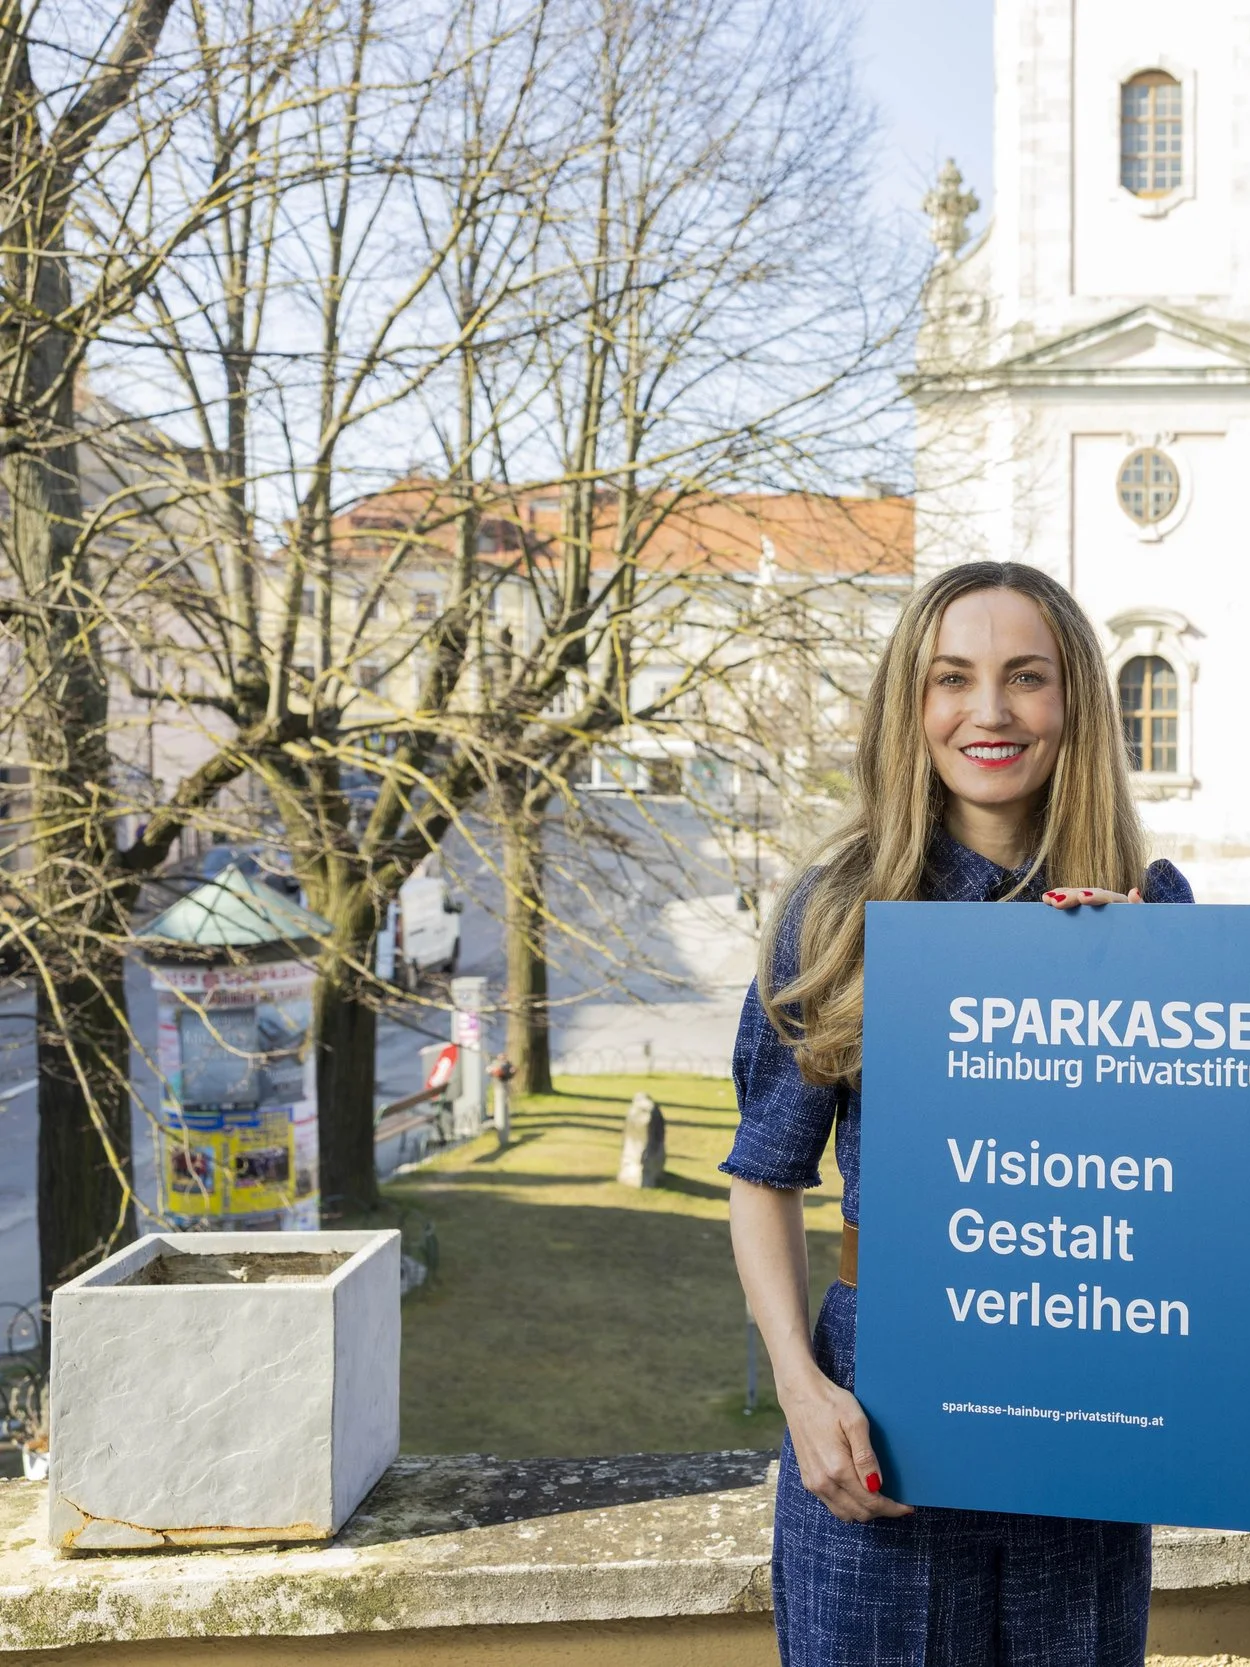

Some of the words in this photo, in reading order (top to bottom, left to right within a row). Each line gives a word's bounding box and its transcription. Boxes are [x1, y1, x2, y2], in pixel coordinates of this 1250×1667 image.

[947, 1050, 1083, 1089] Hainburg
[946, 1138, 1173, 1193] Visionen
[948, 1207, 1134, 1262] Gestalt
[945, 1282, 1189, 1336] verleihen
[941, 1401, 1164, 1428] sparkasse-hainburg-privatstiftung.at
